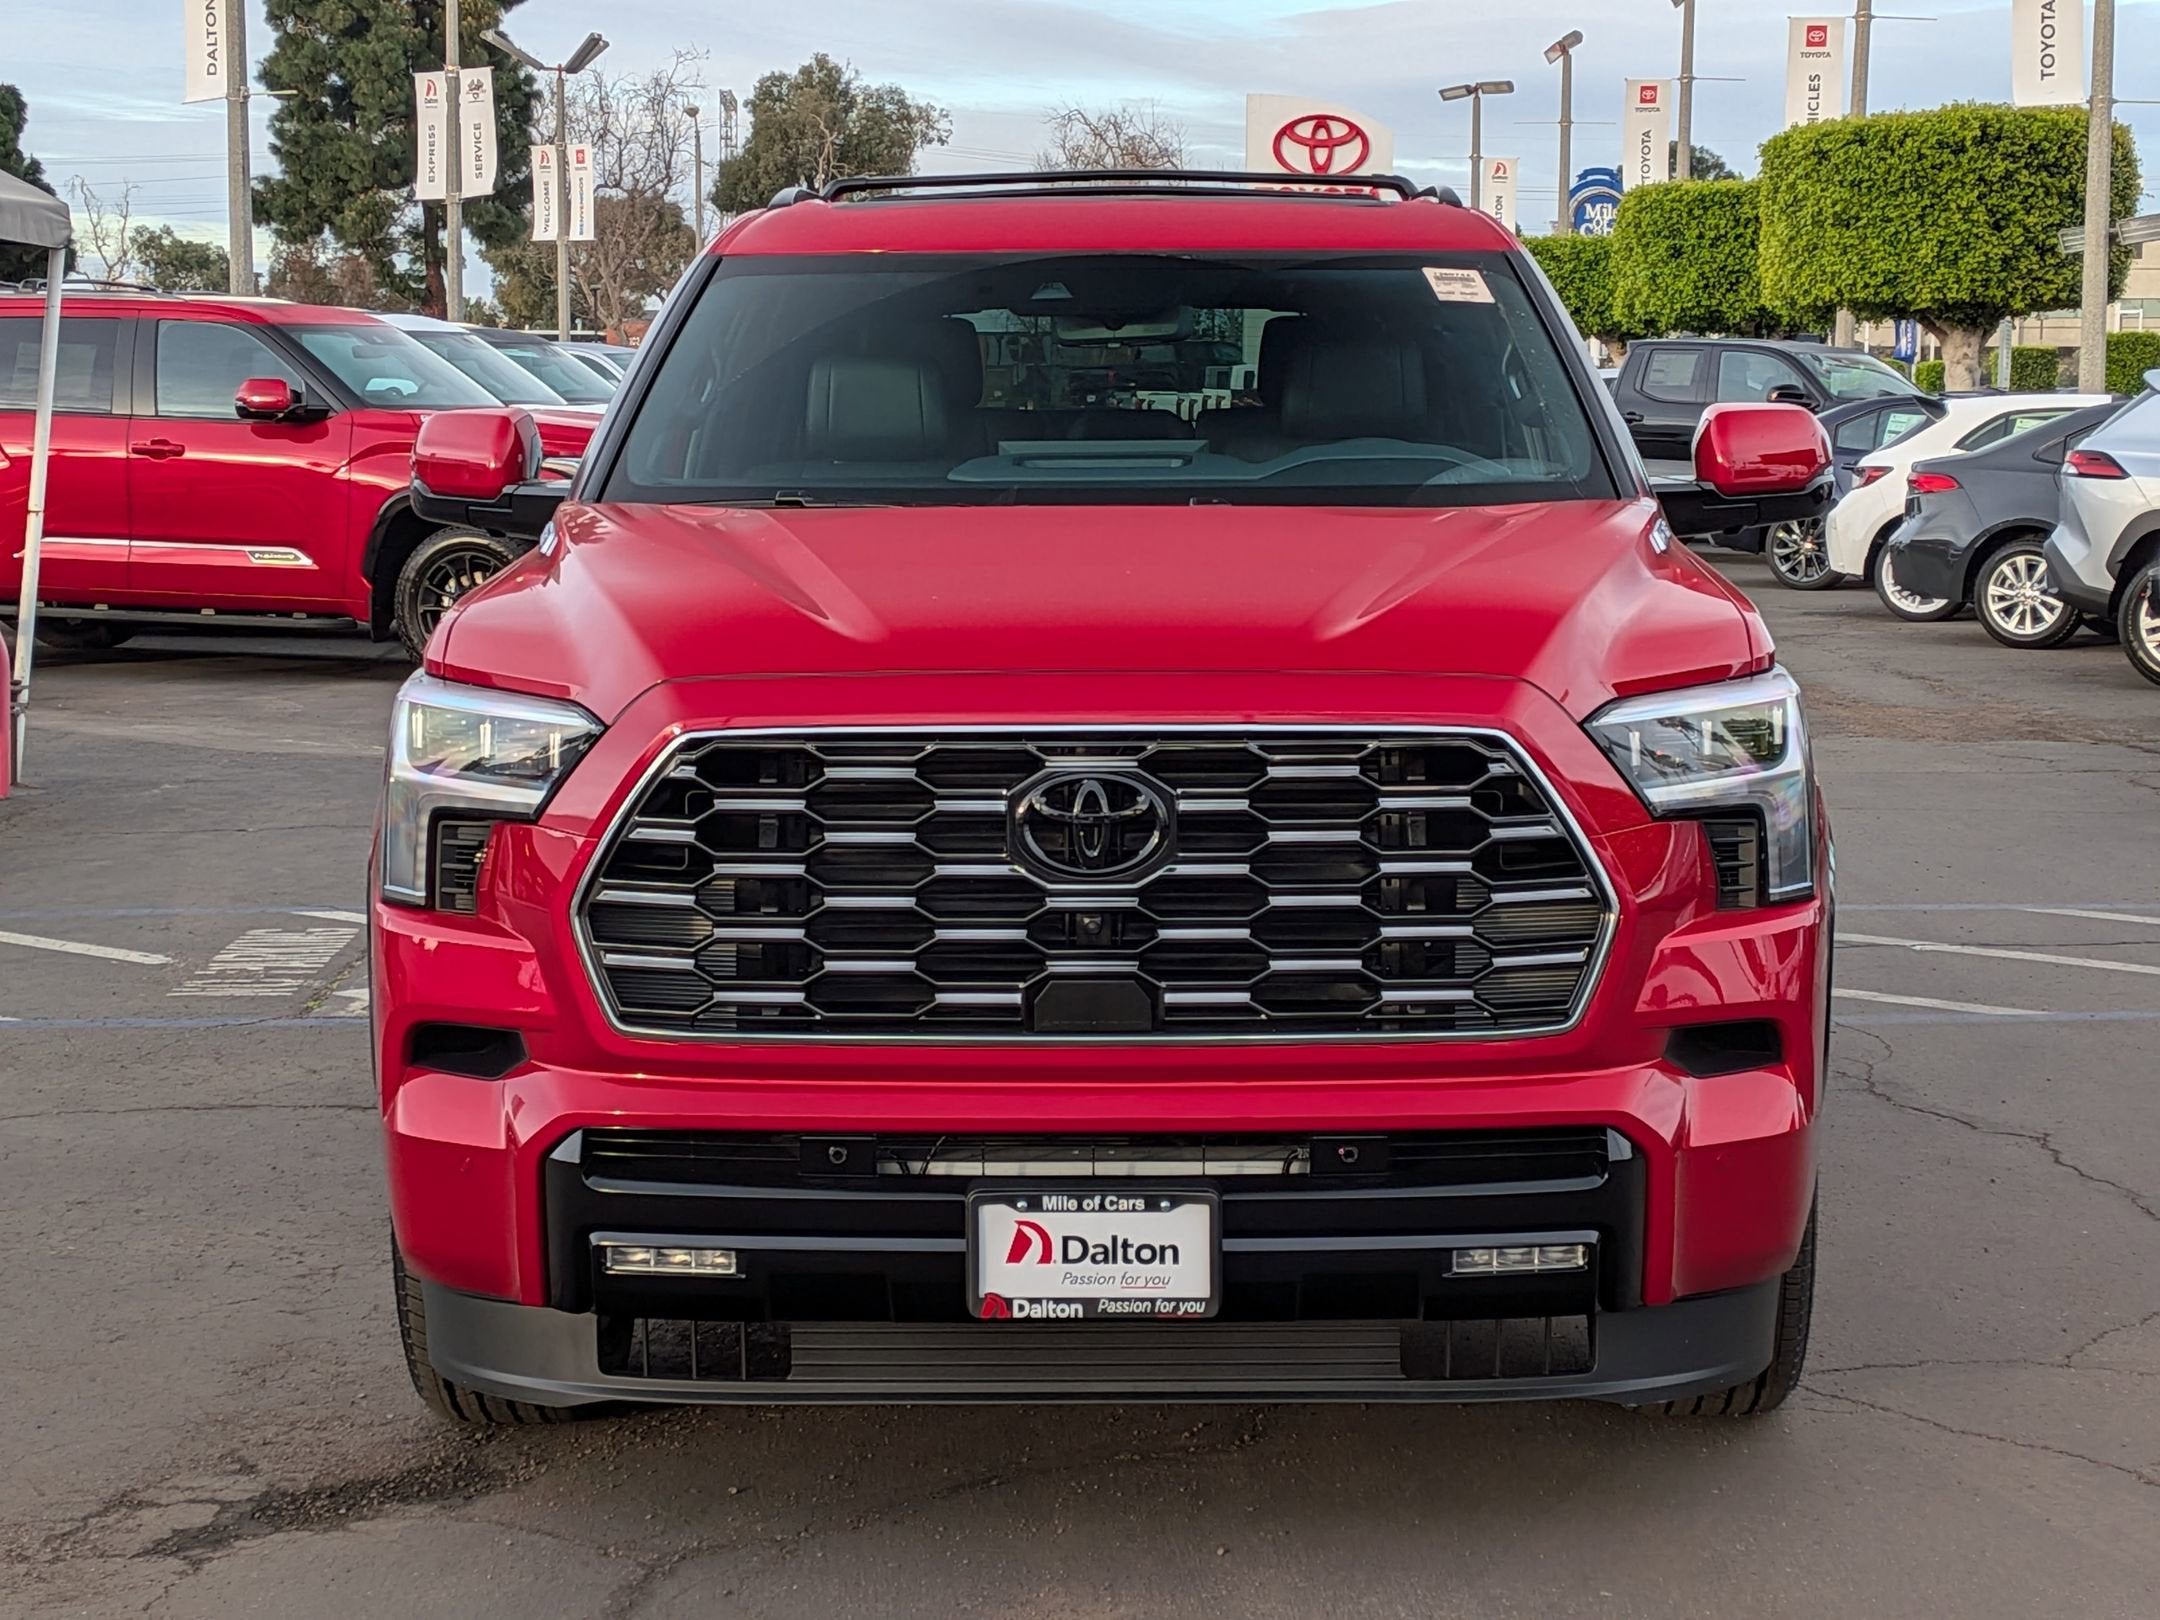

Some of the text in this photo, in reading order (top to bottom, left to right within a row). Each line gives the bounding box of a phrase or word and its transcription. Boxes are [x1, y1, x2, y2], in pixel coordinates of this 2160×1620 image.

[205, 0, 218, 75] DALTON
[2040, 0, 2056, 81] TOYOTA
[428, 124, 436, 183] EXPRESS
[473, 122, 483, 179] SERVICE
[1640, 130, 1652, 185] TOYOTA
[543, 181, 551, 233] WELCOME
[1042, 1195, 1145, 1211] Mile of Cars
[1061, 1235, 1180, 1265] Dalton
[1061, 1272, 1171, 1287] Passion for you
[1012, 1300, 1083, 1318] Dalton
[1097, 1299, 1205, 1316] Passion for you
